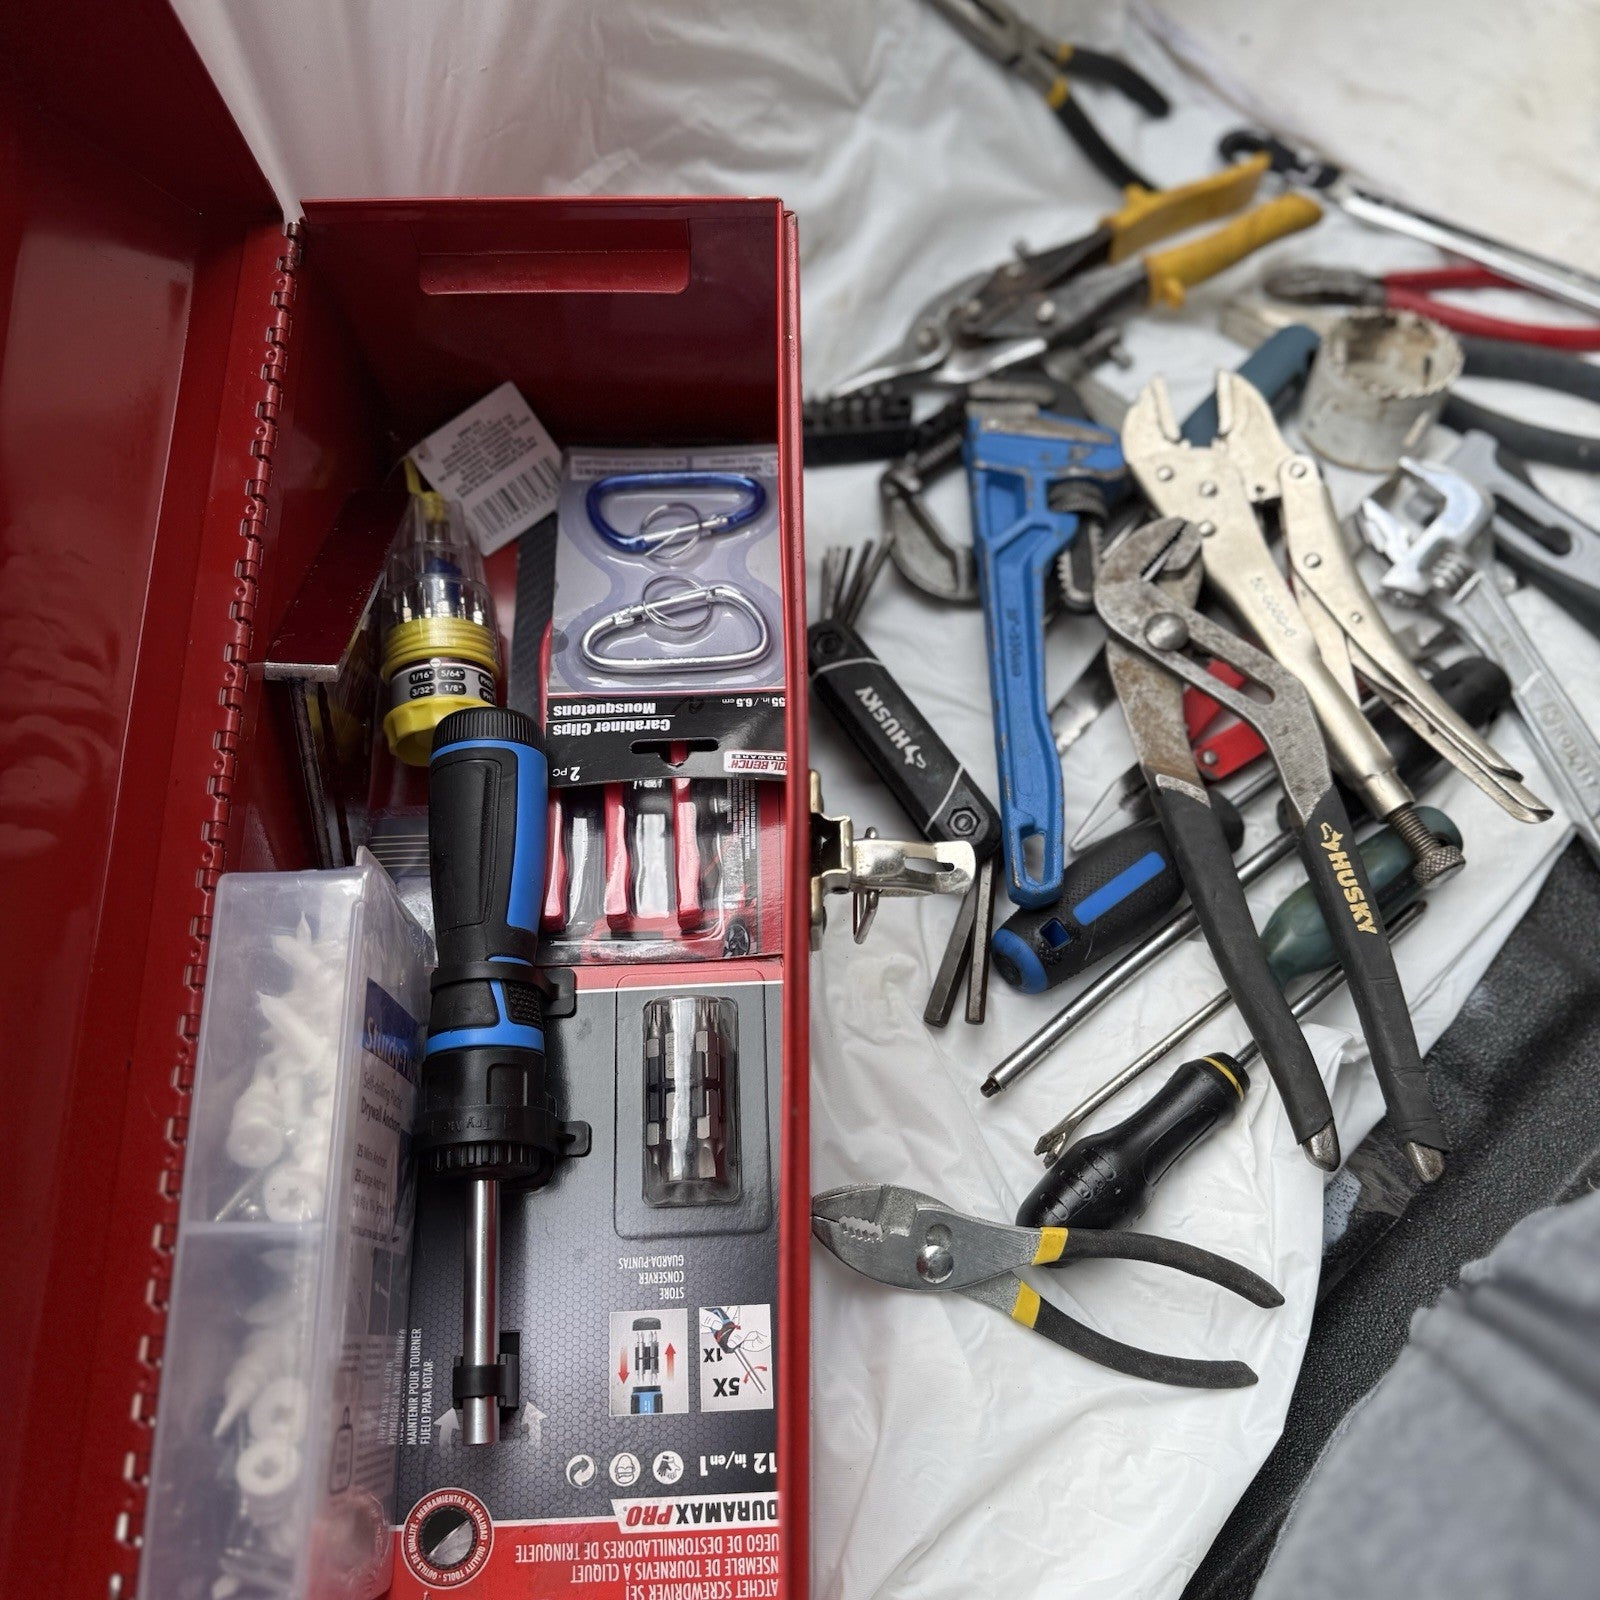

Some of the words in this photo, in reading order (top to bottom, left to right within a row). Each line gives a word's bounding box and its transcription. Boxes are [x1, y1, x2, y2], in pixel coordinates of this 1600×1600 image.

[411, 671, 434, 681] 1/16"
[441, 670, 464, 678] 5/64"
[412, 686, 434, 696] 3/32"
[445, 684, 462, 692] 1/8"
[553, 702, 656, 717] Mousquetons
[736, 698, 753, 708] 6.5
[594, 719, 670, 734] Carabiner
[855, 686, 907, 749] HUSKY
[552, 722, 592, 736] Clips
[552, 767, 568, 776] PC
[570, 766, 580, 782] 2
[730, 760, 769, 770] BENCH
[1328, 852, 1378, 934] HUSKY
[618, 1254, 684, 1270] GUARDA-PUNTAS
[638, 1271, 684, 1284] CONSERVER
[659, 1286, 684, 1299] STORE
[410, 1328, 422, 1368] TOURNER
[703, 1347, 723, 1363] 1X
[408, 1370, 419, 1394] POUR
[712, 1377, 740, 1397] 5X
[421, 1390, 432, 1414] PARA
[406, 1396, 418, 1445] MAINTENIR
[700, 1456, 708, 1476] 1
[710, 1451, 747, 1470] in/en
[754, 1452, 777, 1474] 12
[416, 1494, 466, 1519] HERRAMIENTAS
[466, 1500, 476, 1511] DE
[474, 1511, 488, 1539] CALIDAD
[626, 1504, 674, 1527] PRO
[675, 1499, 778, 1526] DURAMAX
[516, 1543, 580, 1563] TRINQUETE
[584, 1541, 600, 1560] DE
[602, 1537, 722, 1559] DESTORNILLADORES
[726, 1535, 742, 1553] DE
[411, 1552, 420, 1564] DE
[464, 1546, 486, 1574] QUALITY
[725, 1556, 778, 1576] NSEMBLE
[416, 1560, 438, 1580] OUTILS
[442, 1569, 464, 1582] TOOLS
[571, 1564, 620, 1583] CLIQUET
[624, 1563, 632, 1583] À
[635, 1559, 703, 1581] TOURNEVIS
[705, 1559, 720, 1577] DE
[647, 1583, 732, 1600] SCREWDRIVER
[736, 1578, 778, 1598] ATCHET
